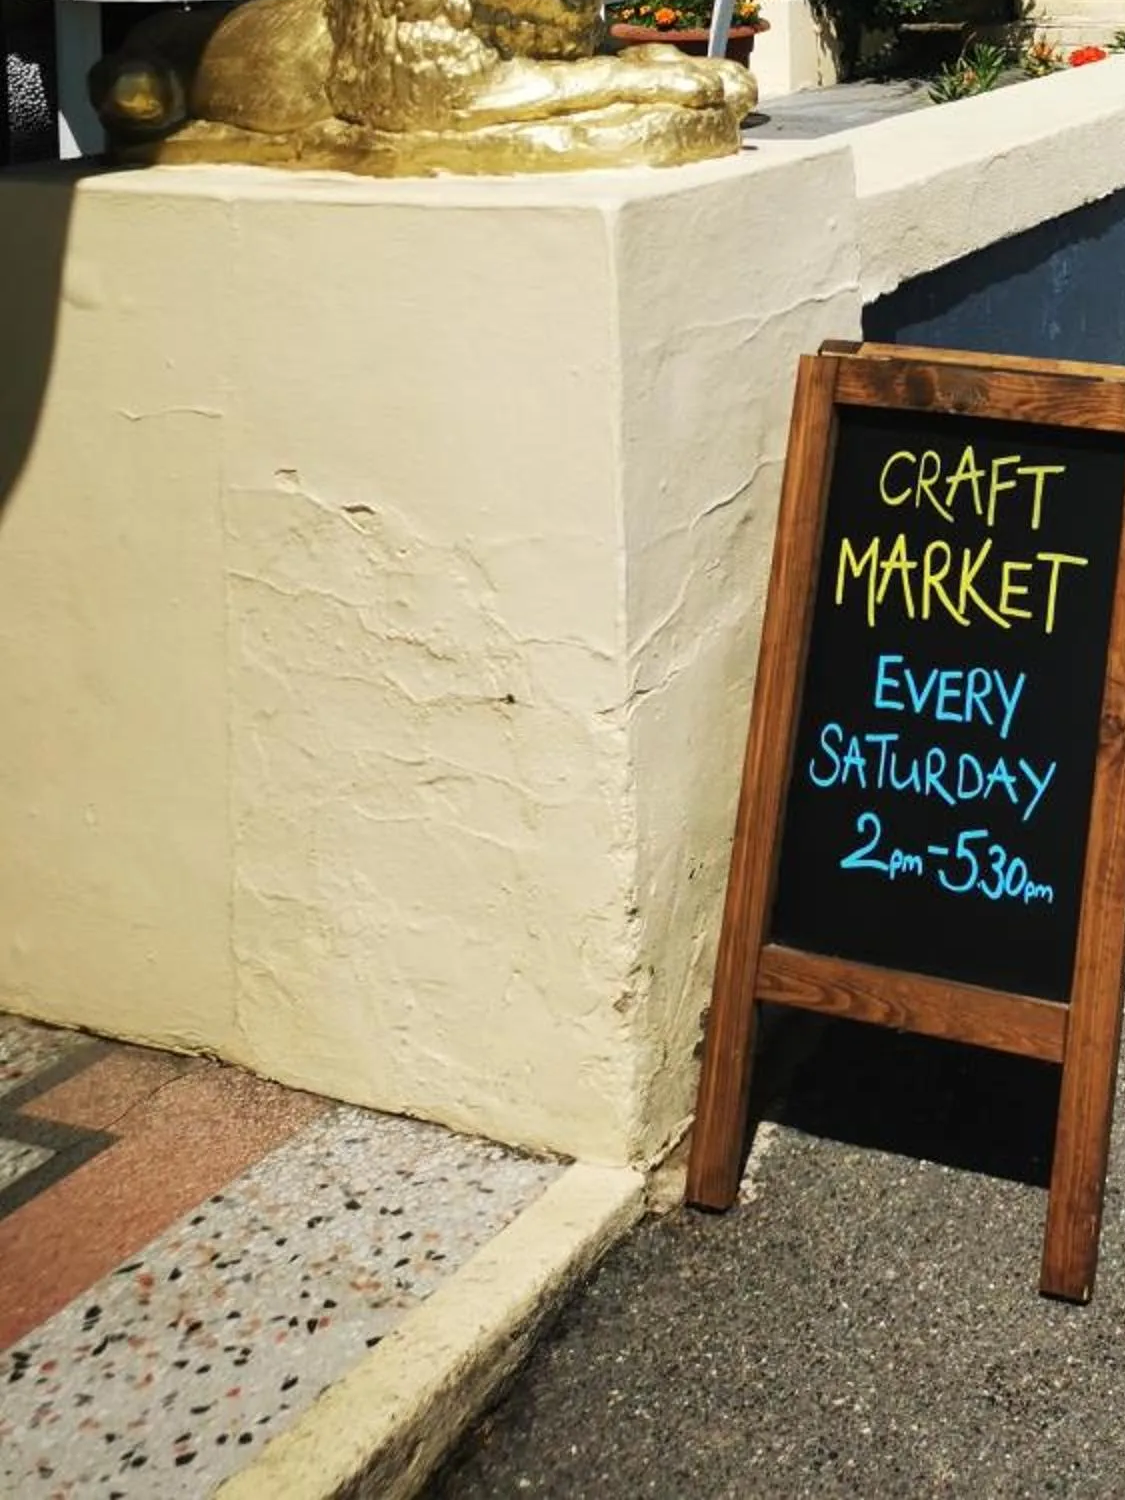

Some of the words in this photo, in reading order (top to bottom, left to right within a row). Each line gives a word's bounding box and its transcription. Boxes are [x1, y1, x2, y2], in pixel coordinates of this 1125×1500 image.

[880, 445, 1066, 530] CRAFT
[835, 533, 1089, 633] MARKET
[874, 654, 1027, 740] EVERY
[809, 722, 1057, 822] SATURDAY
